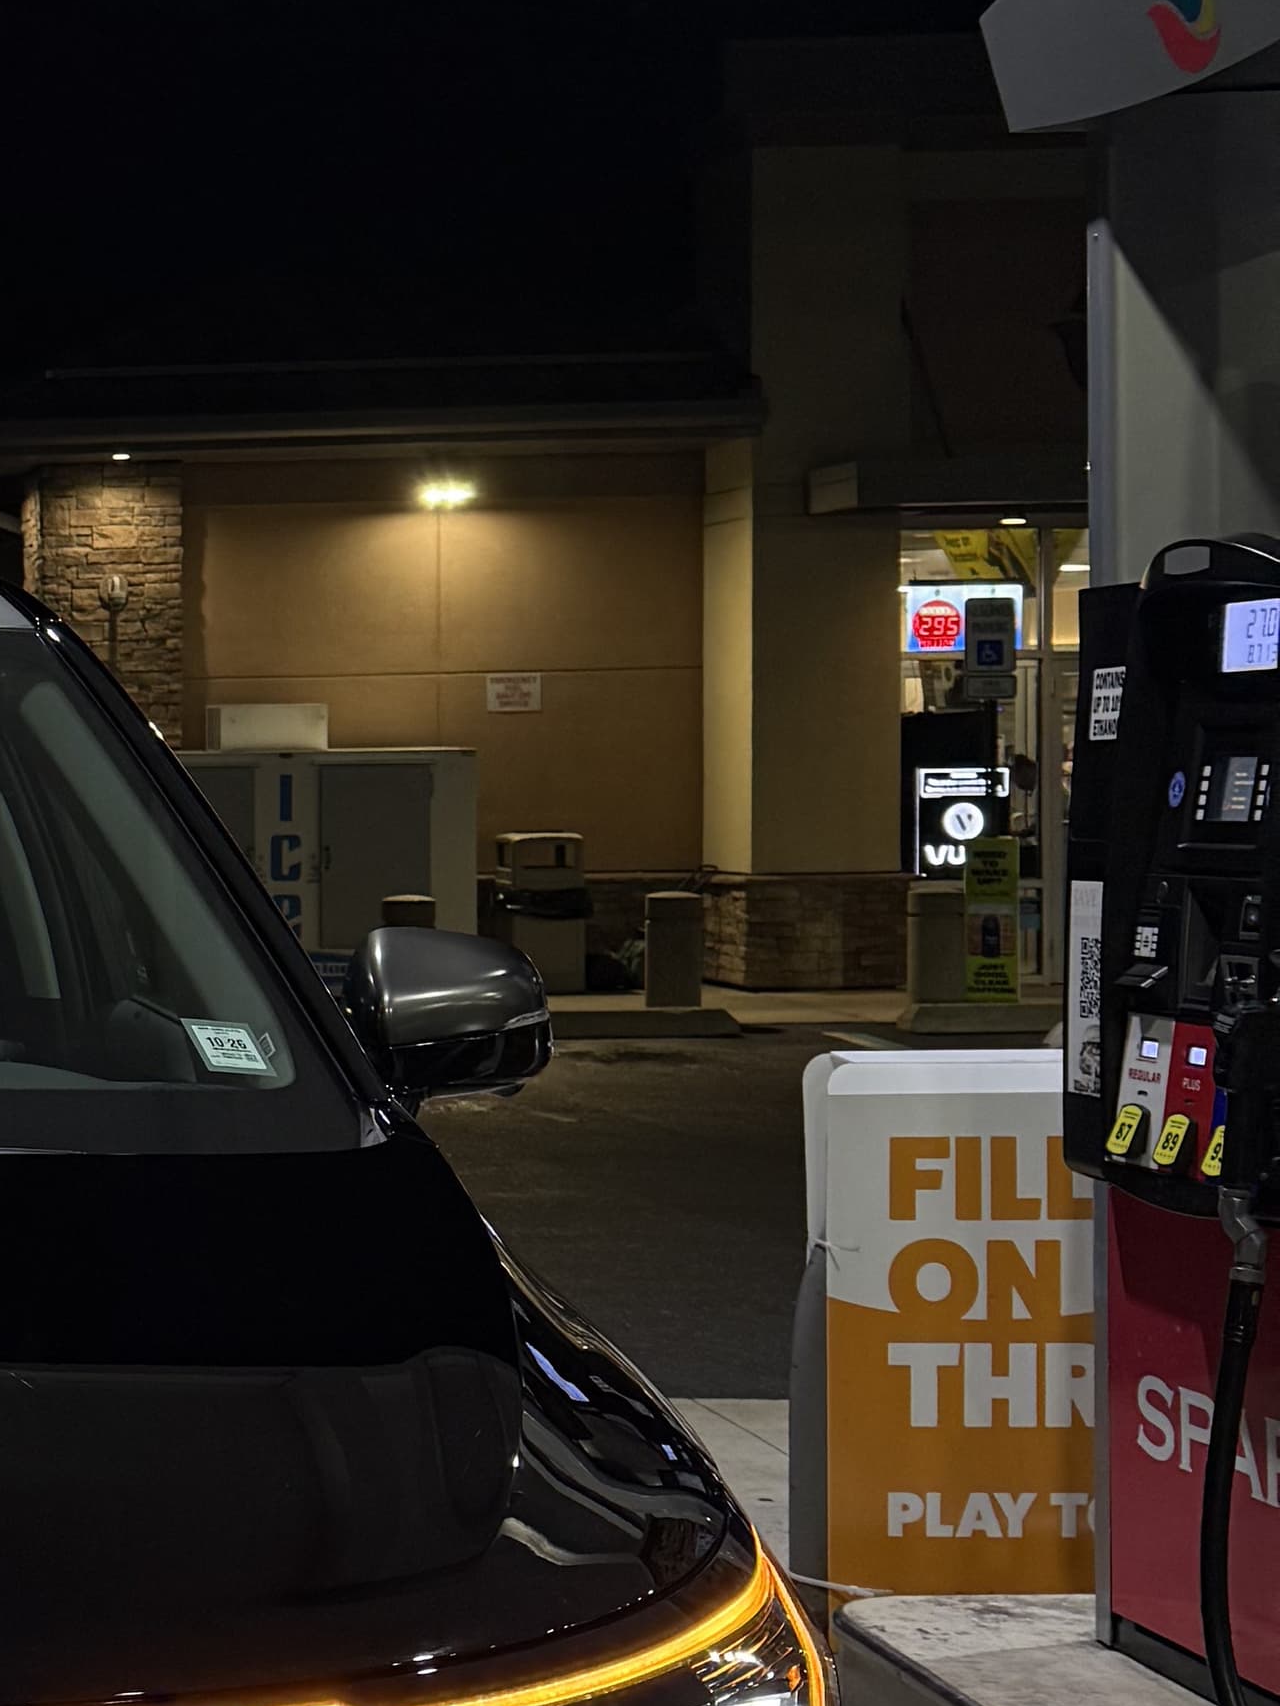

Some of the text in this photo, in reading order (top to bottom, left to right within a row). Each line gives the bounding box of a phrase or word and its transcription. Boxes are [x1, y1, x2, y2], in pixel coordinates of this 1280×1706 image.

[1093, 718, 1117, 737] ETHANO
[206, 1037, 224, 1048] 10
[1128, 1068, 1162, 1084] REGULAR
[1181, 1077, 1201, 1092] PLUS
[1115, 1122, 1133, 1142] 87
[1162, 1132, 1179, 1151] 89
[1210, 1143, 1222, 1162] 9
[888, 1238, 1061, 1321] ON
[887, 1491, 1095, 1538] PLAY T
